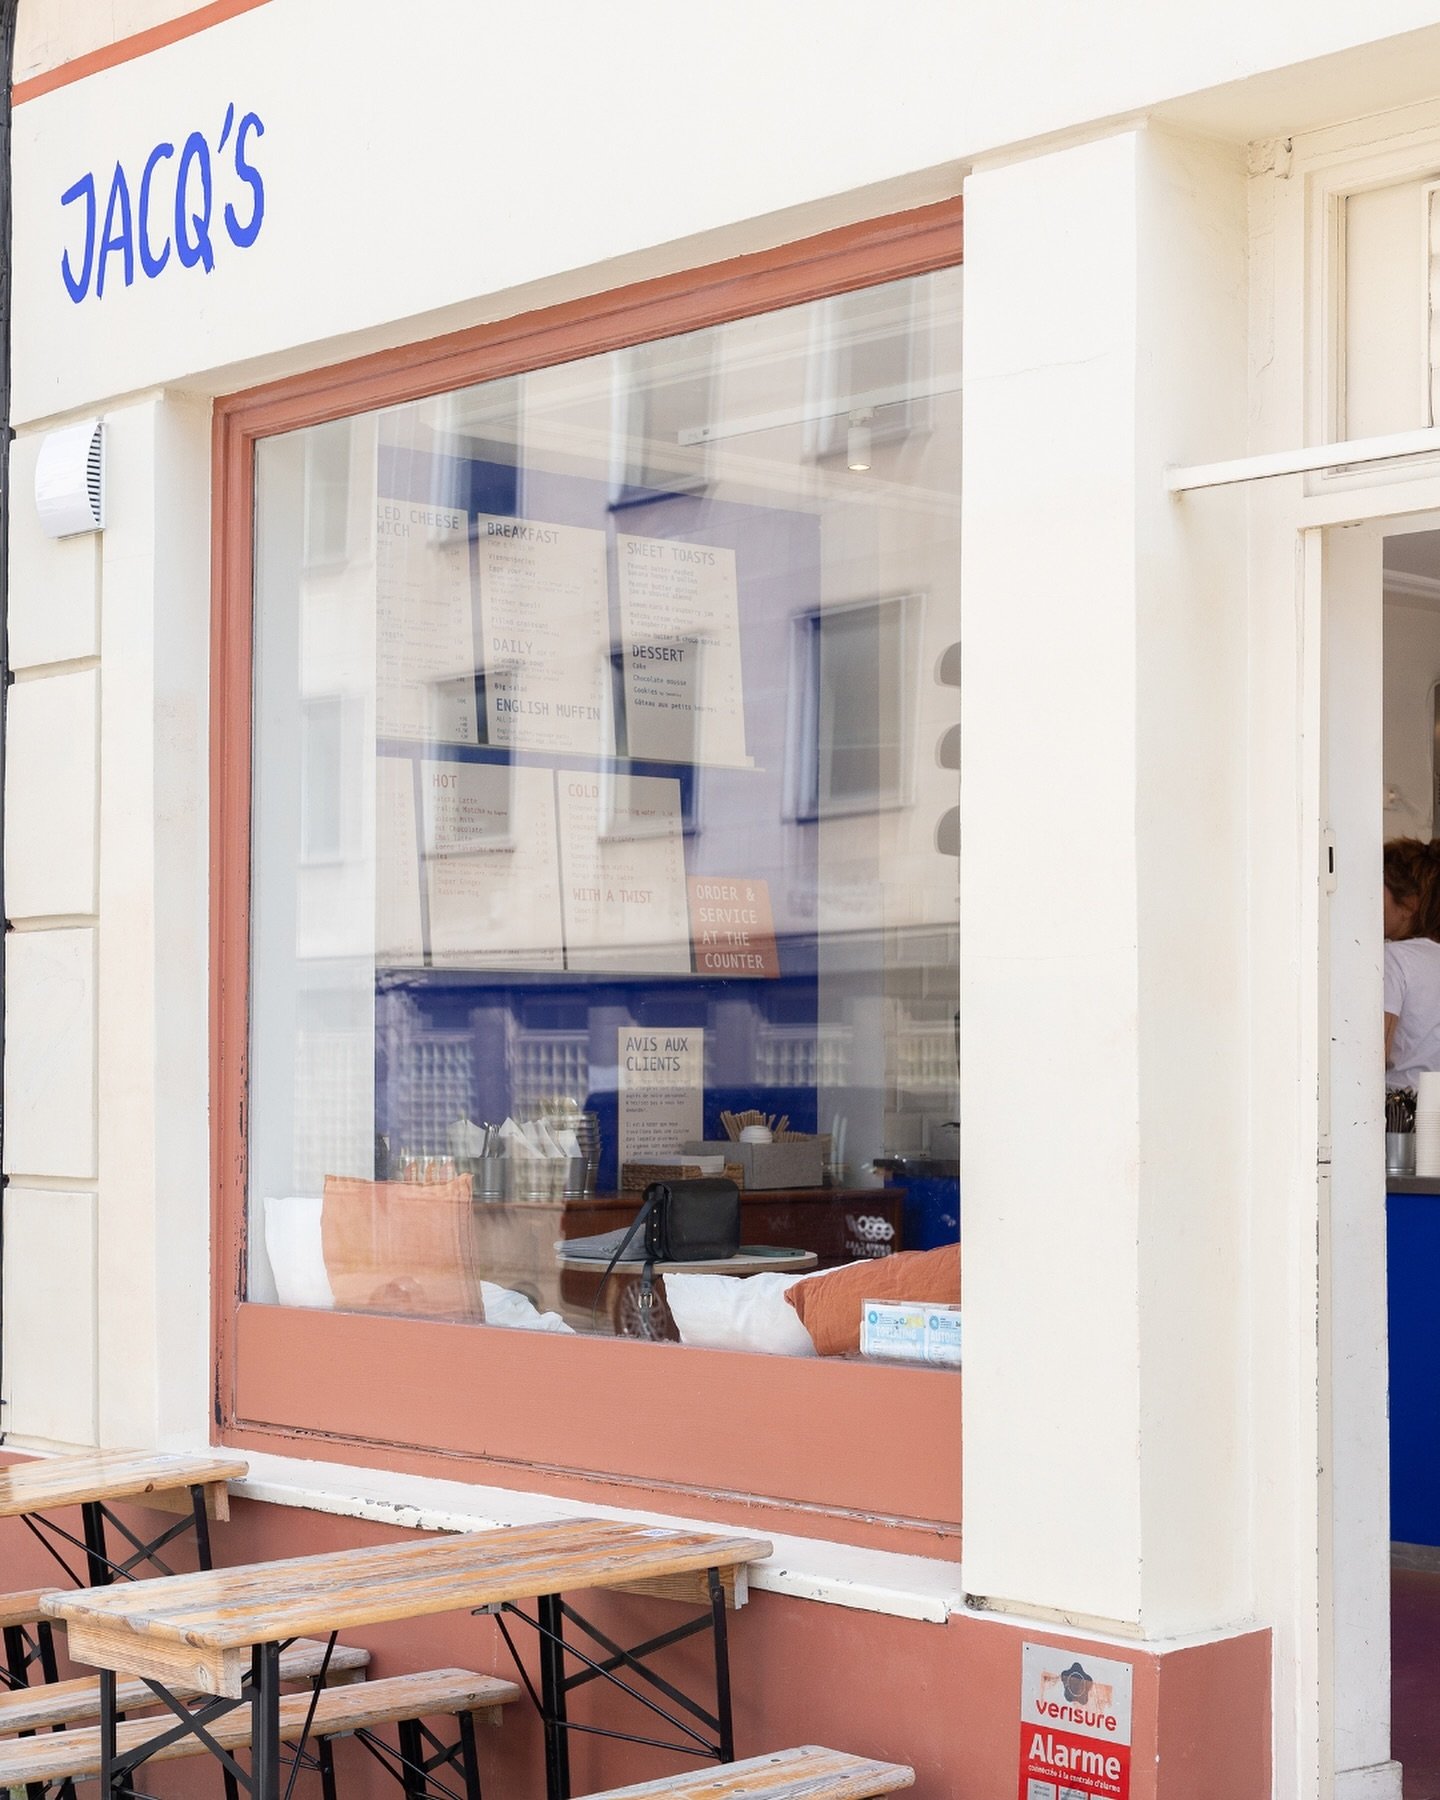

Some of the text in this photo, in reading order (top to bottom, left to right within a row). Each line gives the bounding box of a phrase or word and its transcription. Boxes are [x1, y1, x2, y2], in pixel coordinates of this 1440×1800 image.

[60, 101, 266, 304] JACQ'S
[410, 510, 459, 529] CHEESE
[487, 522, 560, 545] BREAKFAST
[627, 541, 716, 566] SWEET TOASTS
[493, 638, 533, 655] DAILY
[632, 644, 685, 662] DESSERT
[632, 662, 647, 670] Cake
[633, 674, 664, 684] Chocolate
[634, 686, 658, 696] Cookies
[496, 698, 600, 720] ENGLISH MUFFIN
[432, 774, 458, 788] HOT
[568, 783, 599, 798] COLD
[573, 887, 653, 904] WITH A TWIST
[696, 884, 756, 902] ORDER &
[699, 907, 758, 924] SERVICE
[702, 930, 750, 946] AT THE
[704, 953, 764, 969] COUNTER
[626, 1036, 688, 1052] AVIS AUX
[626, 1056, 681, 1071] CLIENTS
[1036, 1699, 1117, 1731] verisure
[1029, 1733, 1121, 1780] Alarme
